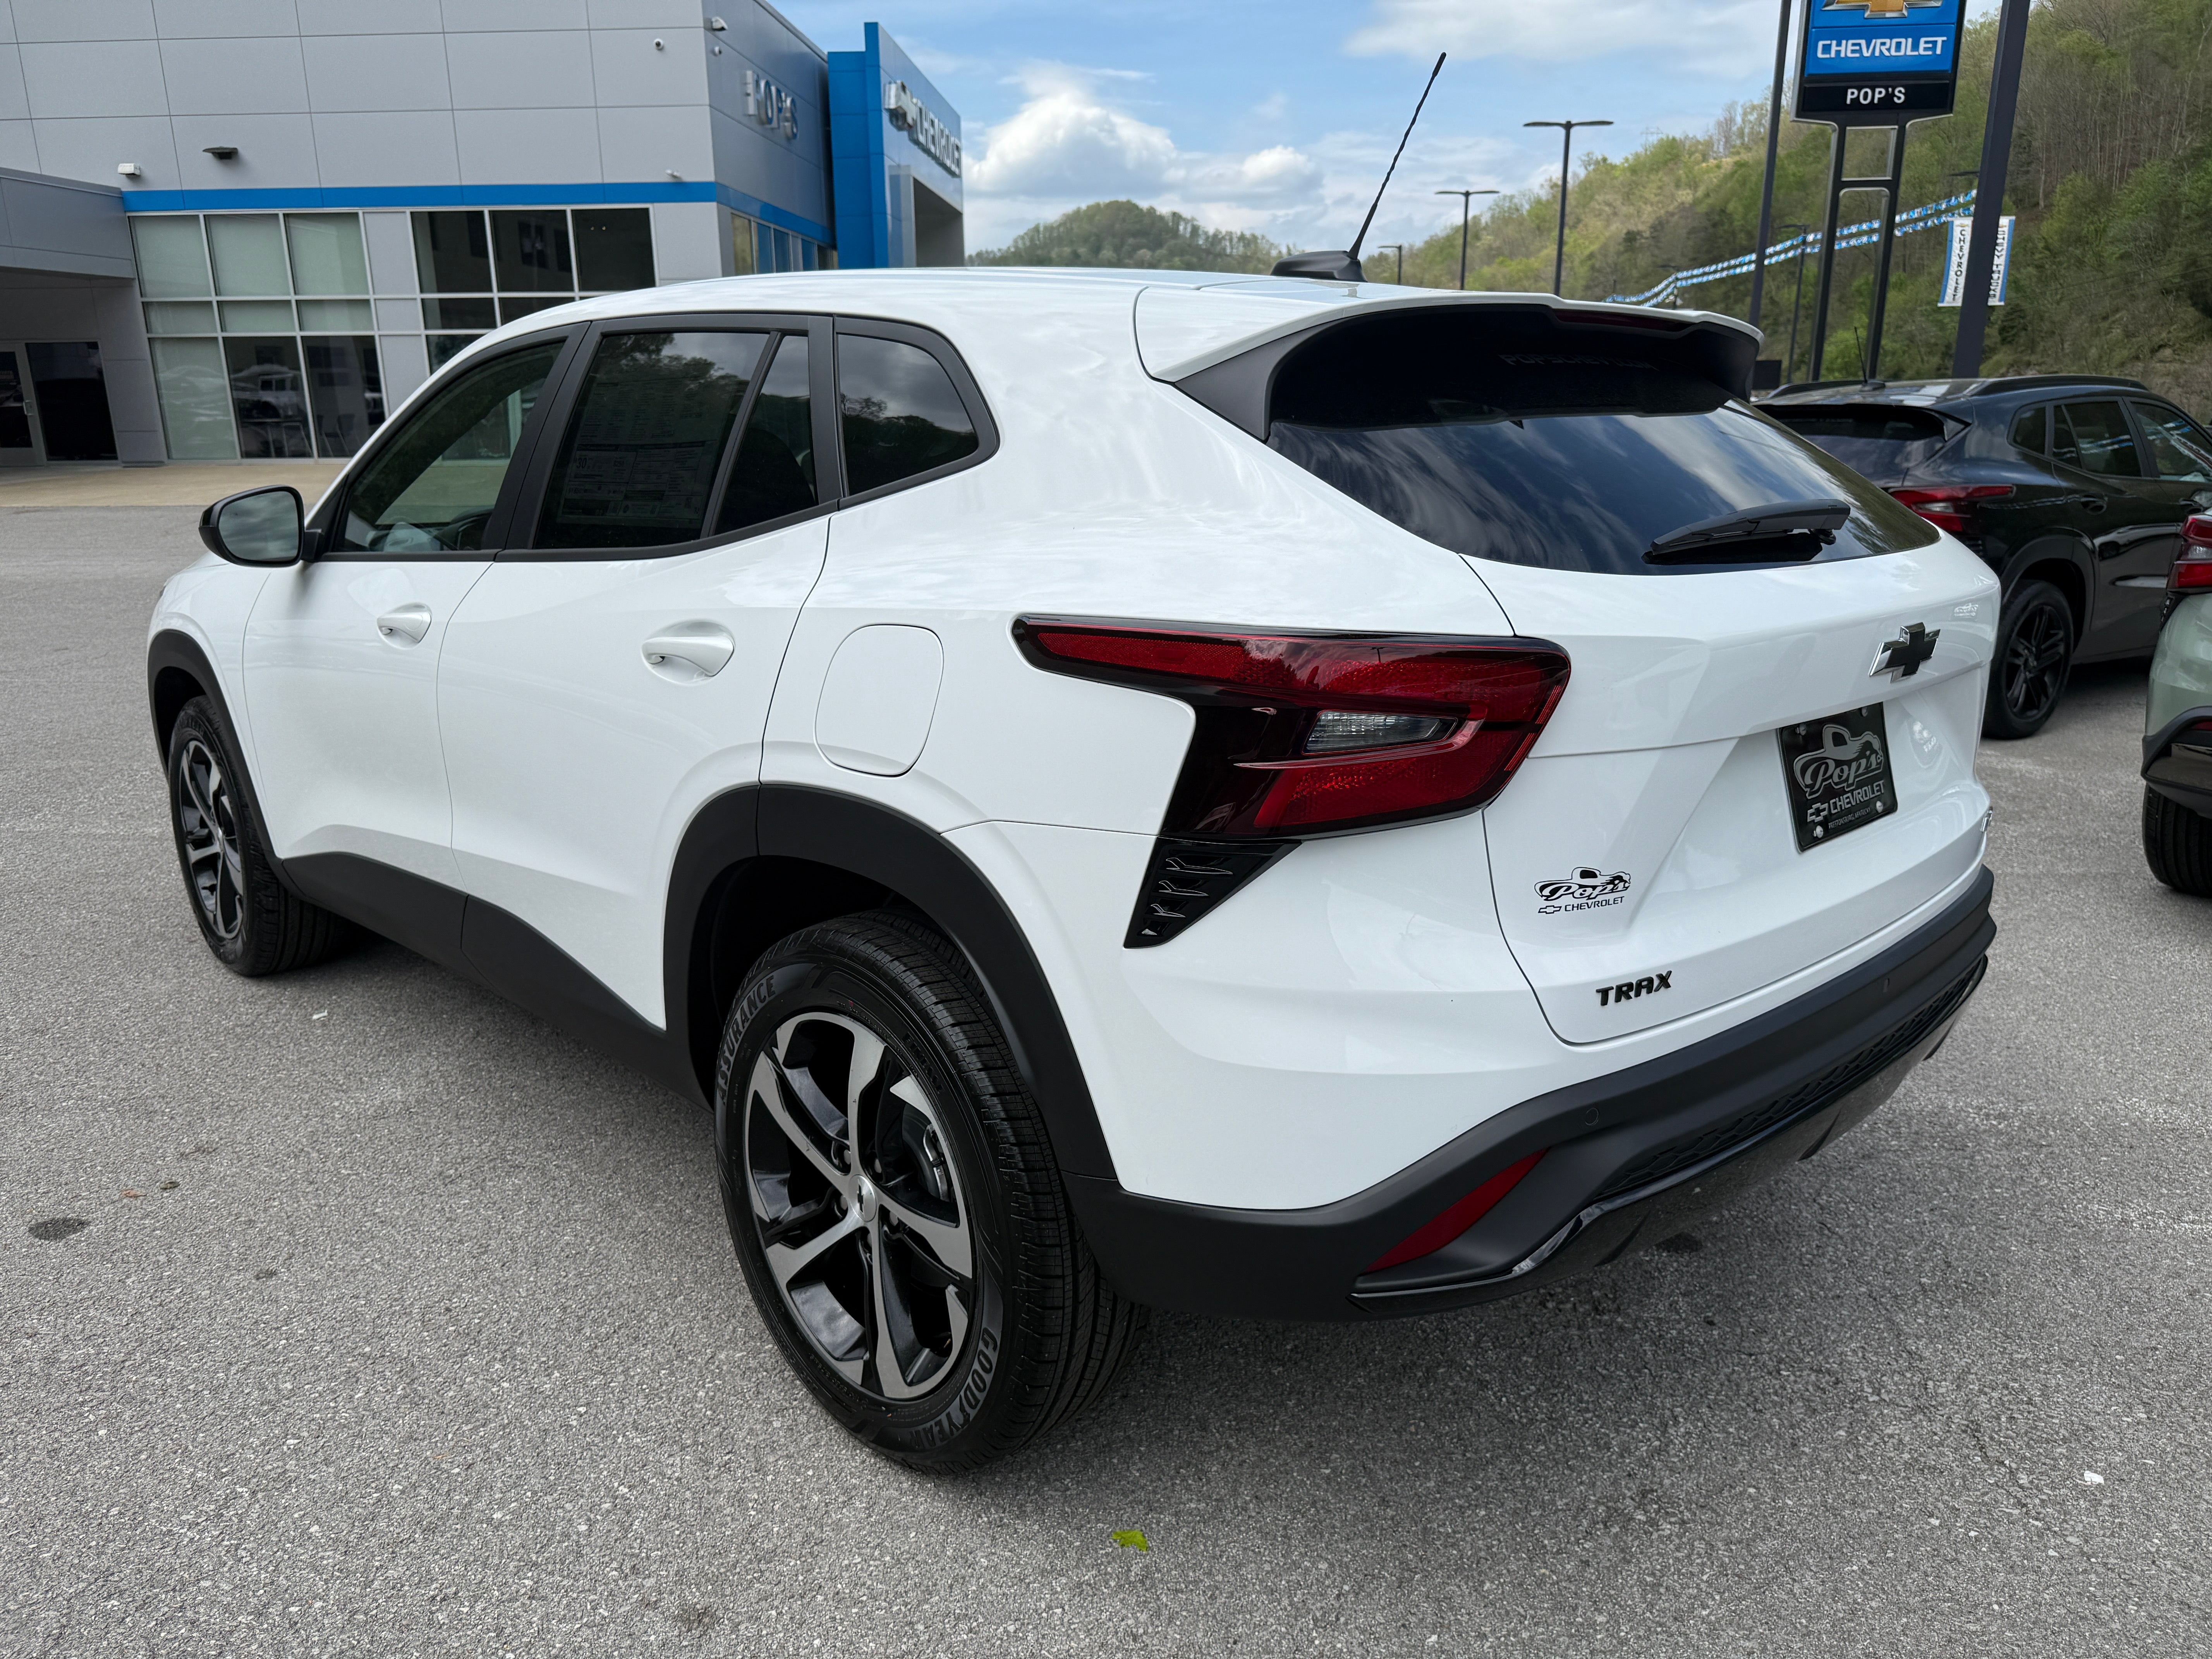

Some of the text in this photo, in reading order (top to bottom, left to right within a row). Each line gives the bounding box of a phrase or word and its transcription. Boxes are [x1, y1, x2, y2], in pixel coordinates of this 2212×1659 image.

[1817, 36, 1947, 58] CHEVROLET
[1846, 87, 1905, 105] POP'S
[1952, 229, 1966, 301] CHEVROLET
[1803, 750, 1883, 792] Pop's
[1830, 780, 1884, 814] CHEVROLET
[1565, 896, 1625, 912] CHEVROLET
[1595, 970, 1672, 1006] TRAX
[717, 975, 775, 1106] ASSURANCE
[910, 1327, 998, 1448] GOODYEAR
